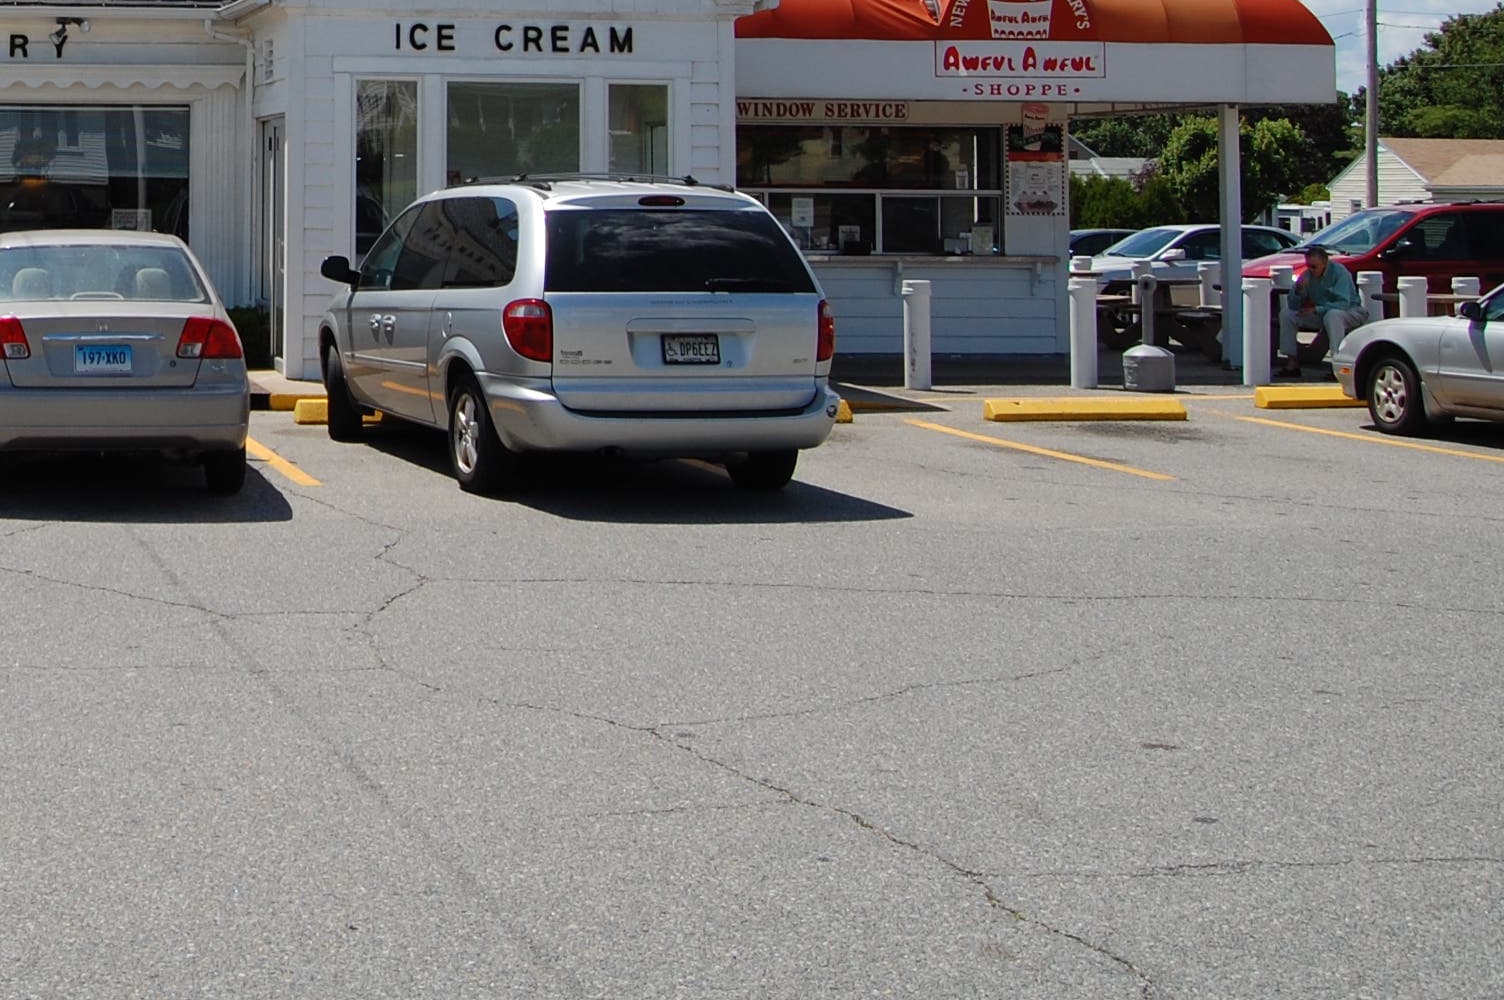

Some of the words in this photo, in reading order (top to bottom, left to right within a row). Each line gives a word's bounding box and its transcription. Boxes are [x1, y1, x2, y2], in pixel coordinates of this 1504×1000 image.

[395, 23, 456, 50] ICE
[494, 24, 633, 53] CREAM
[943, 45, 1016, 71] AWFUL
[1022, 46, 1096, 72] AWFUL
[974, 84, 1068, 96] SHOPPE
[737, 102, 816, 118] WINDOW
[824, 102, 906, 119] SERVICE
